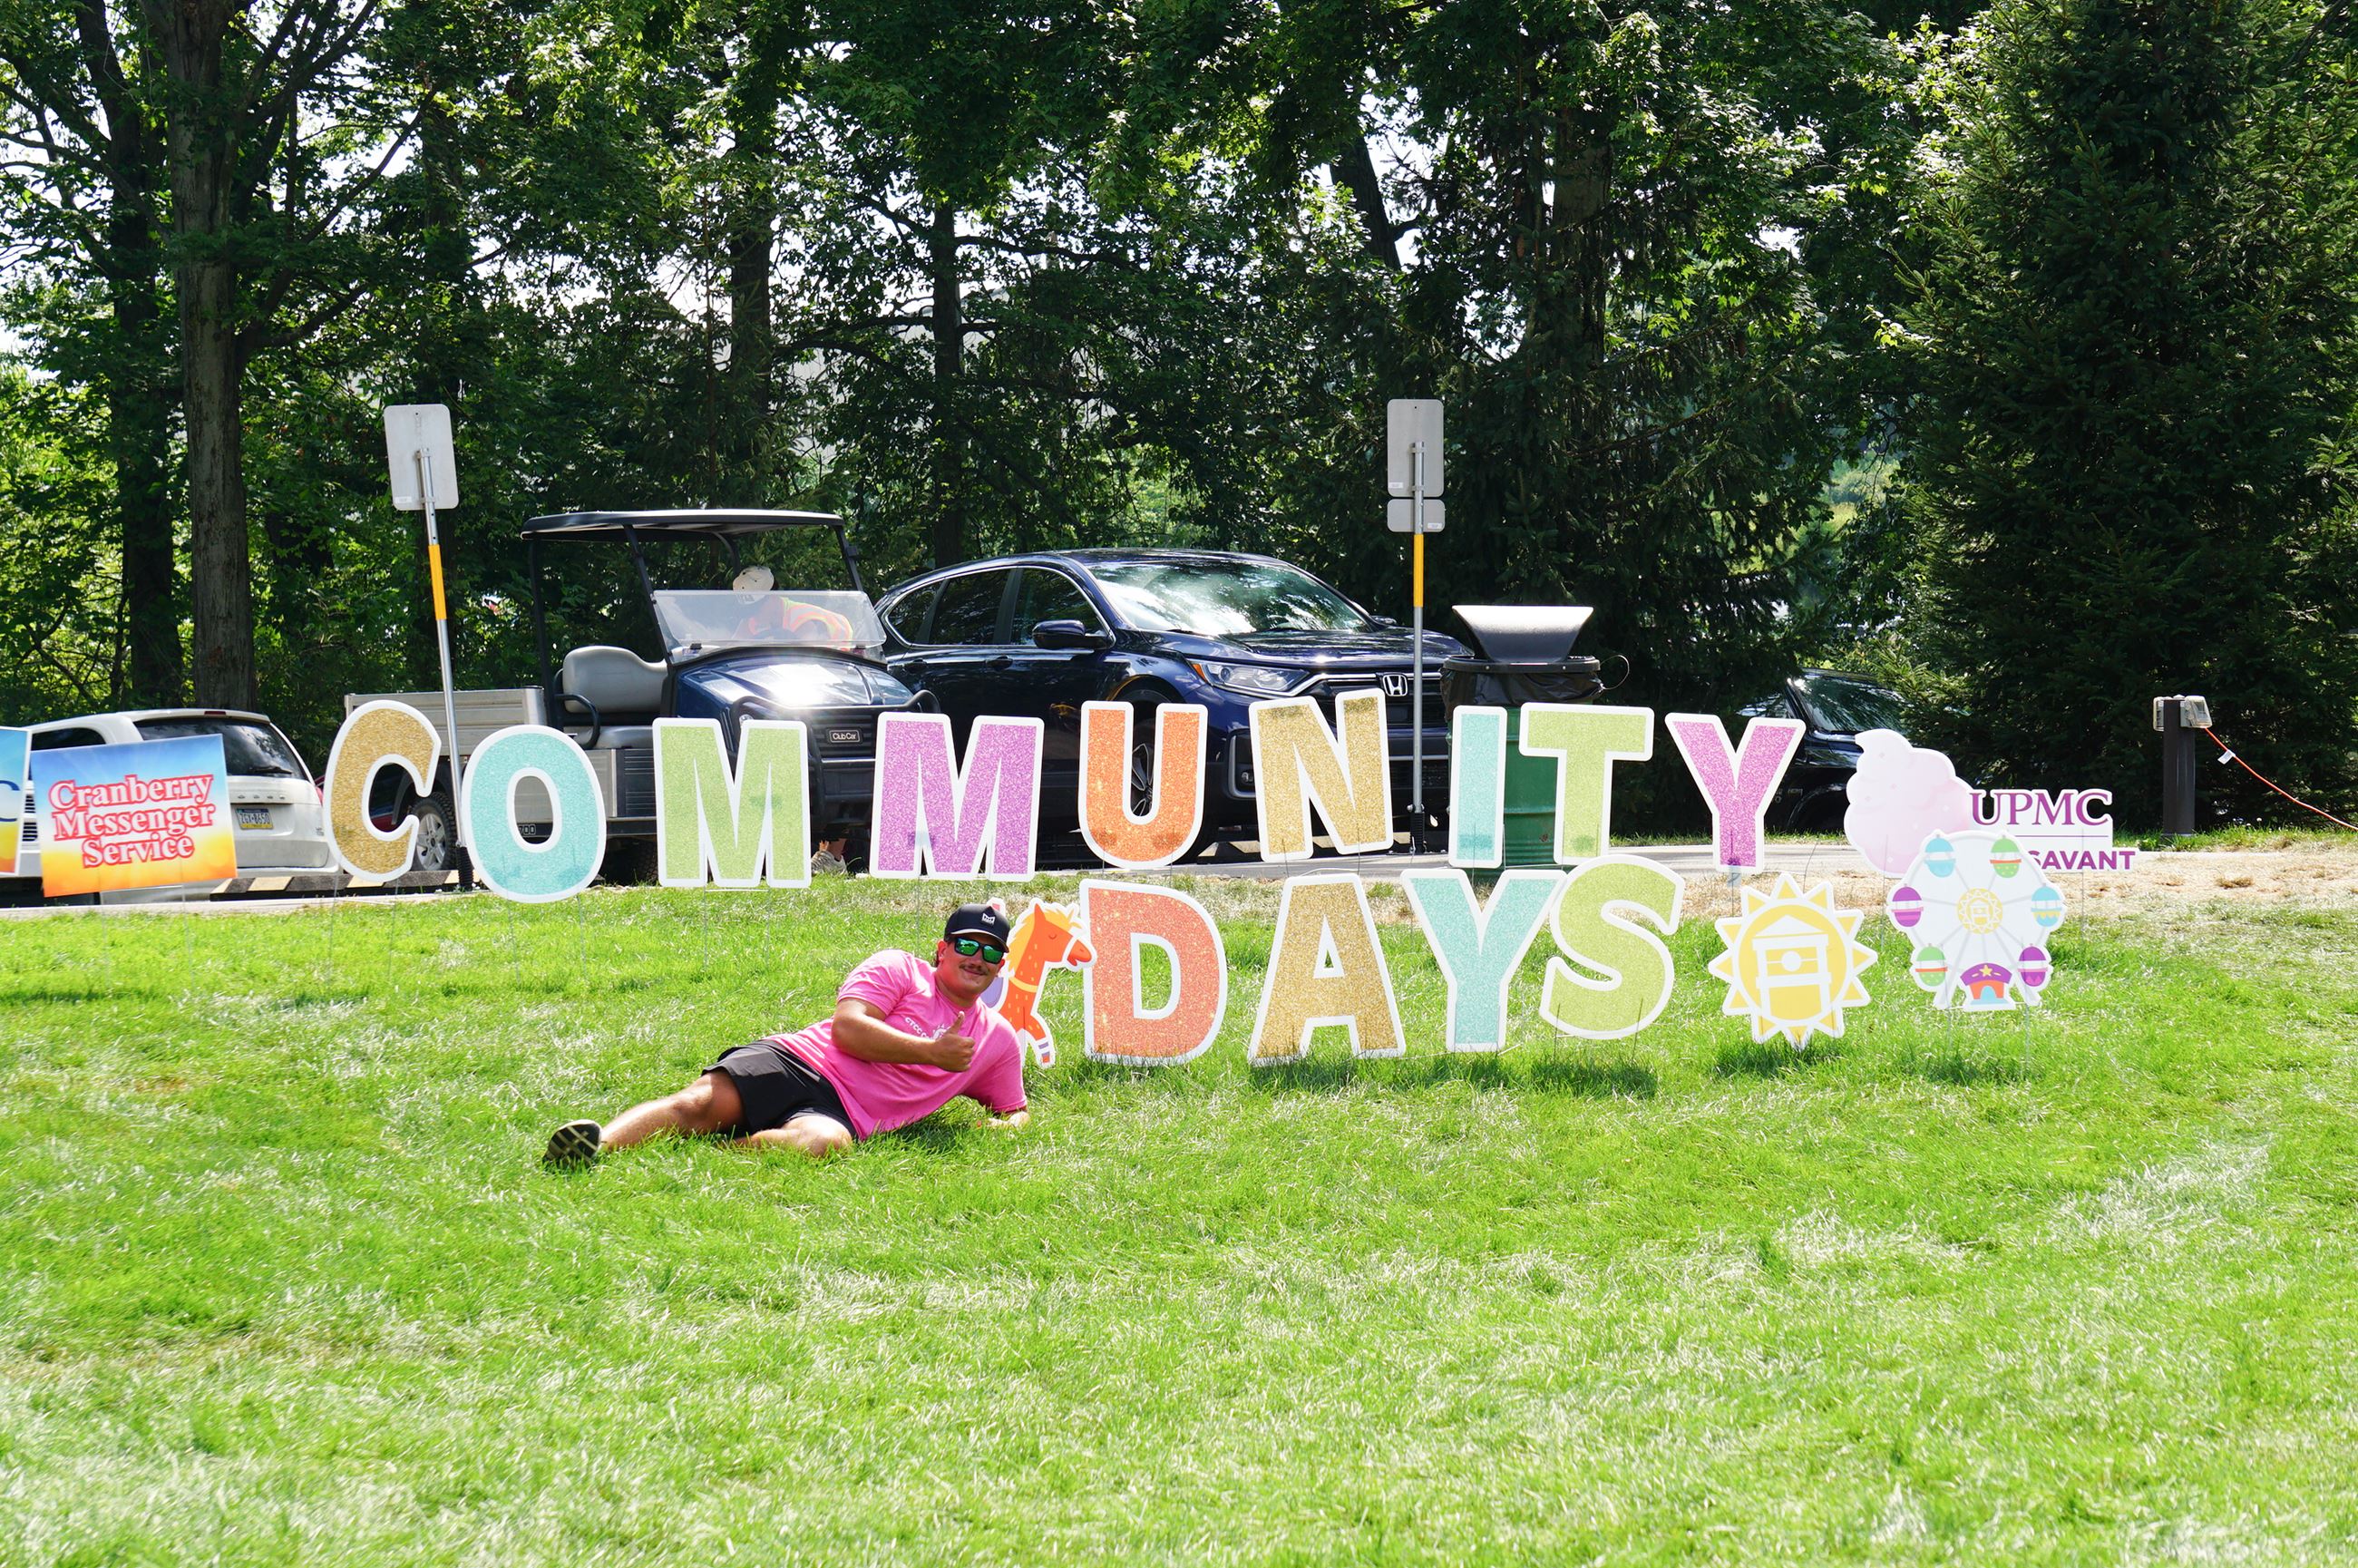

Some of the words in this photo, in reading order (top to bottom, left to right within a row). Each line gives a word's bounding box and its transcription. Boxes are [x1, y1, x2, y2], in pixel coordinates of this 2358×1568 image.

[833, 732, 845, 740] Club
[845, 732, 856, 740] Car
[49, 774, 213, 810] Cranberry
[324, 687, 1807, 903] COMMUNITY
[1969, 792, 2110, 826] UPMC
[52, 803, 216, 836] Messenger
[82, 832, 195, 868] Service
[1079, 854, 1687, 1066] DAYS
